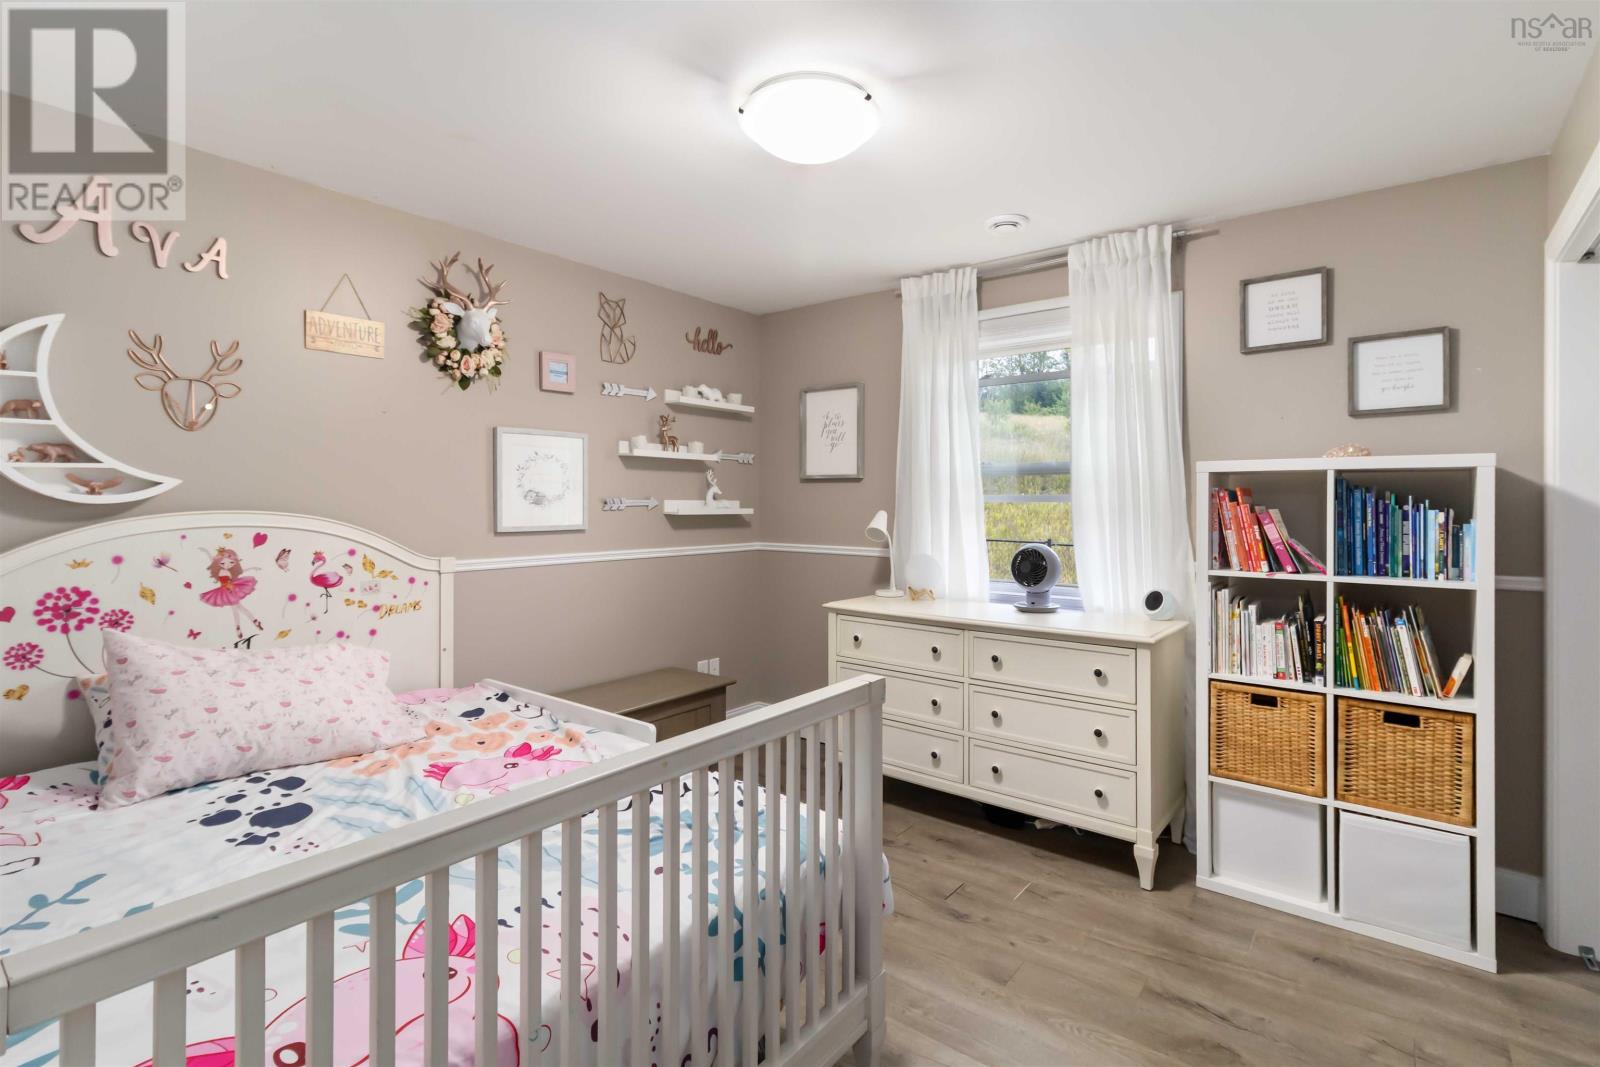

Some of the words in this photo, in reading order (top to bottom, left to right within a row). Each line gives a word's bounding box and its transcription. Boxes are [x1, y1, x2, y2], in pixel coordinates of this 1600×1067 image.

[307, 316, 381, 344] ADVENTURE
[685, 326, 734, 356] hello
[378, 599, 422, 620] DREAMS
